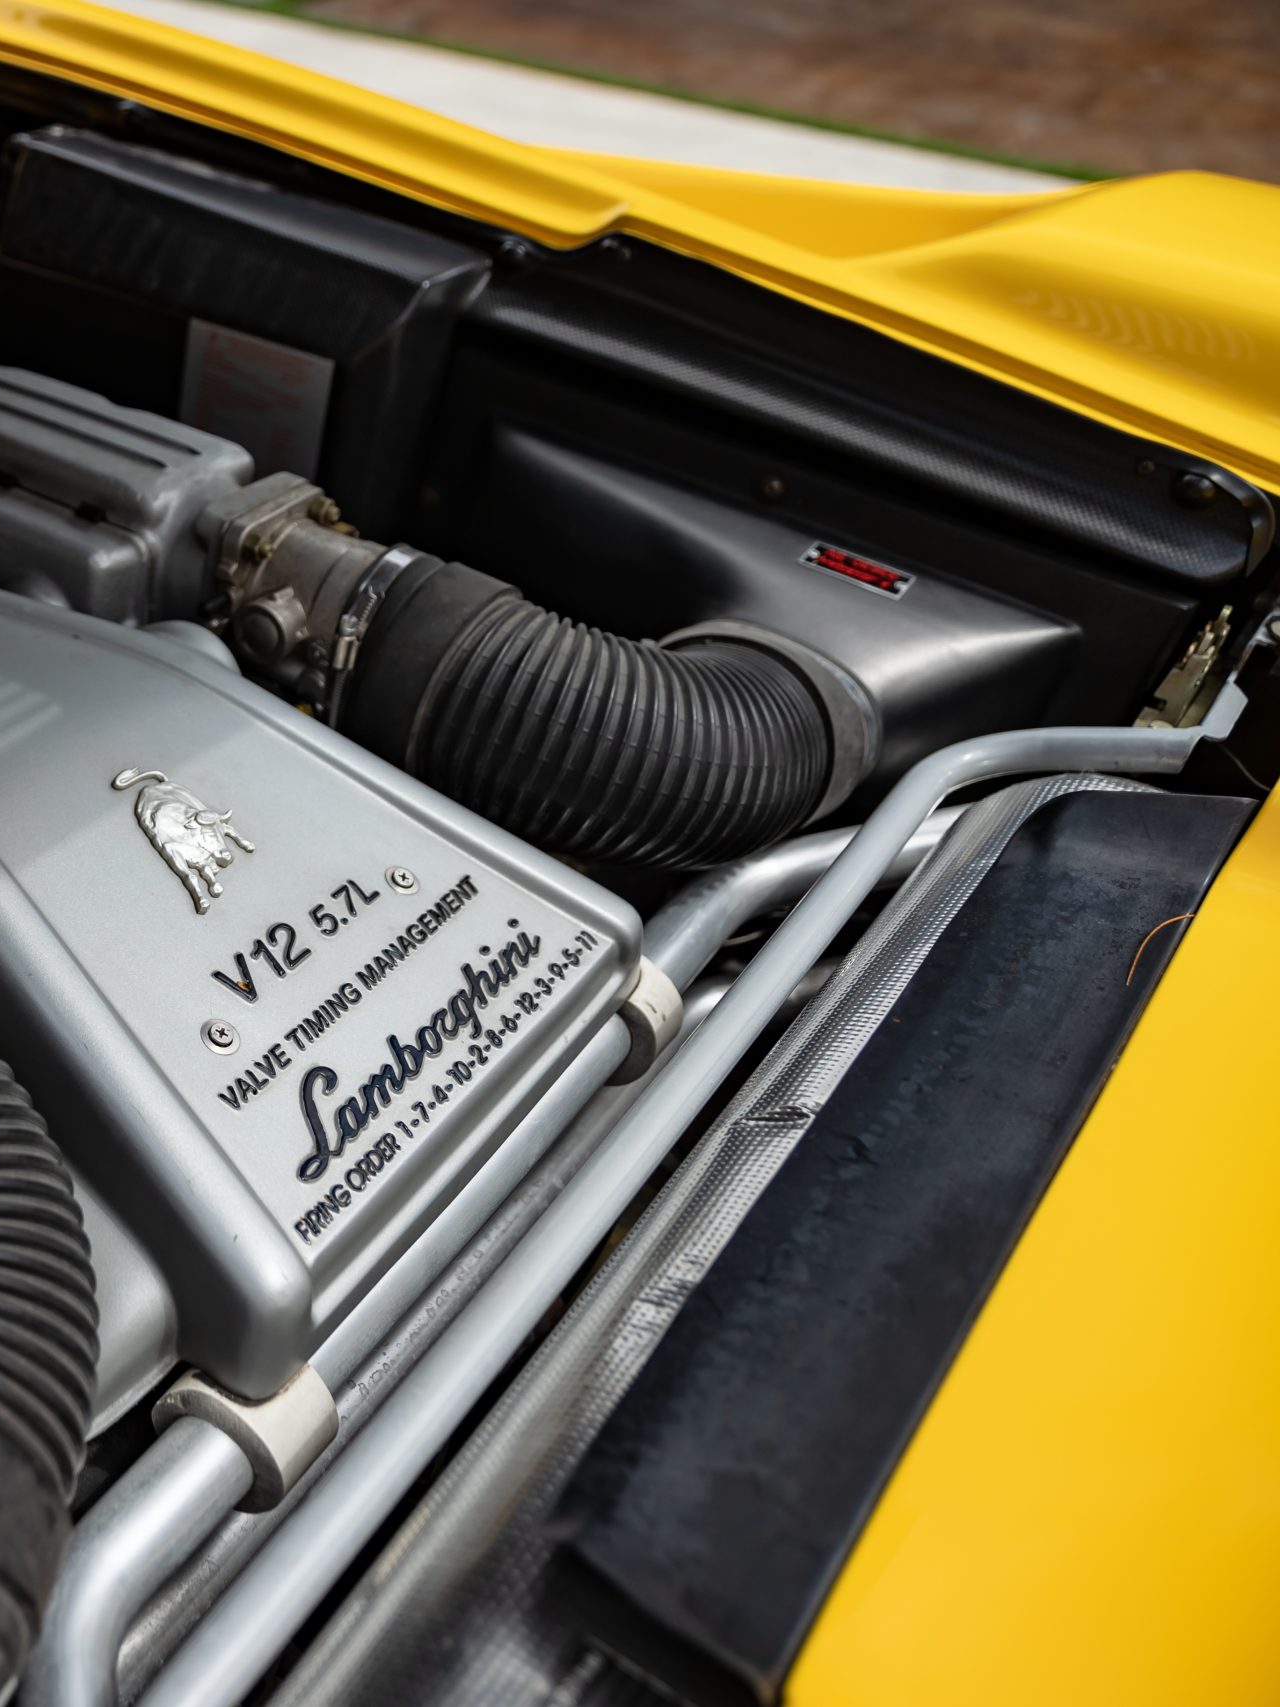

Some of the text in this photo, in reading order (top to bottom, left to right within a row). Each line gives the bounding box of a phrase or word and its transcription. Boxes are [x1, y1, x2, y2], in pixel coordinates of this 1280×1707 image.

[211, 878, 381, 1004] V12 5.7L
[217, 873, 480, 1111] VALVE TIMING MANAGEMENT
[296, 917, 542, 1184] Lamborghini
[294, 1183, 353, 1246] FIRING
[344, 1131, 402, 1193] ORDER
